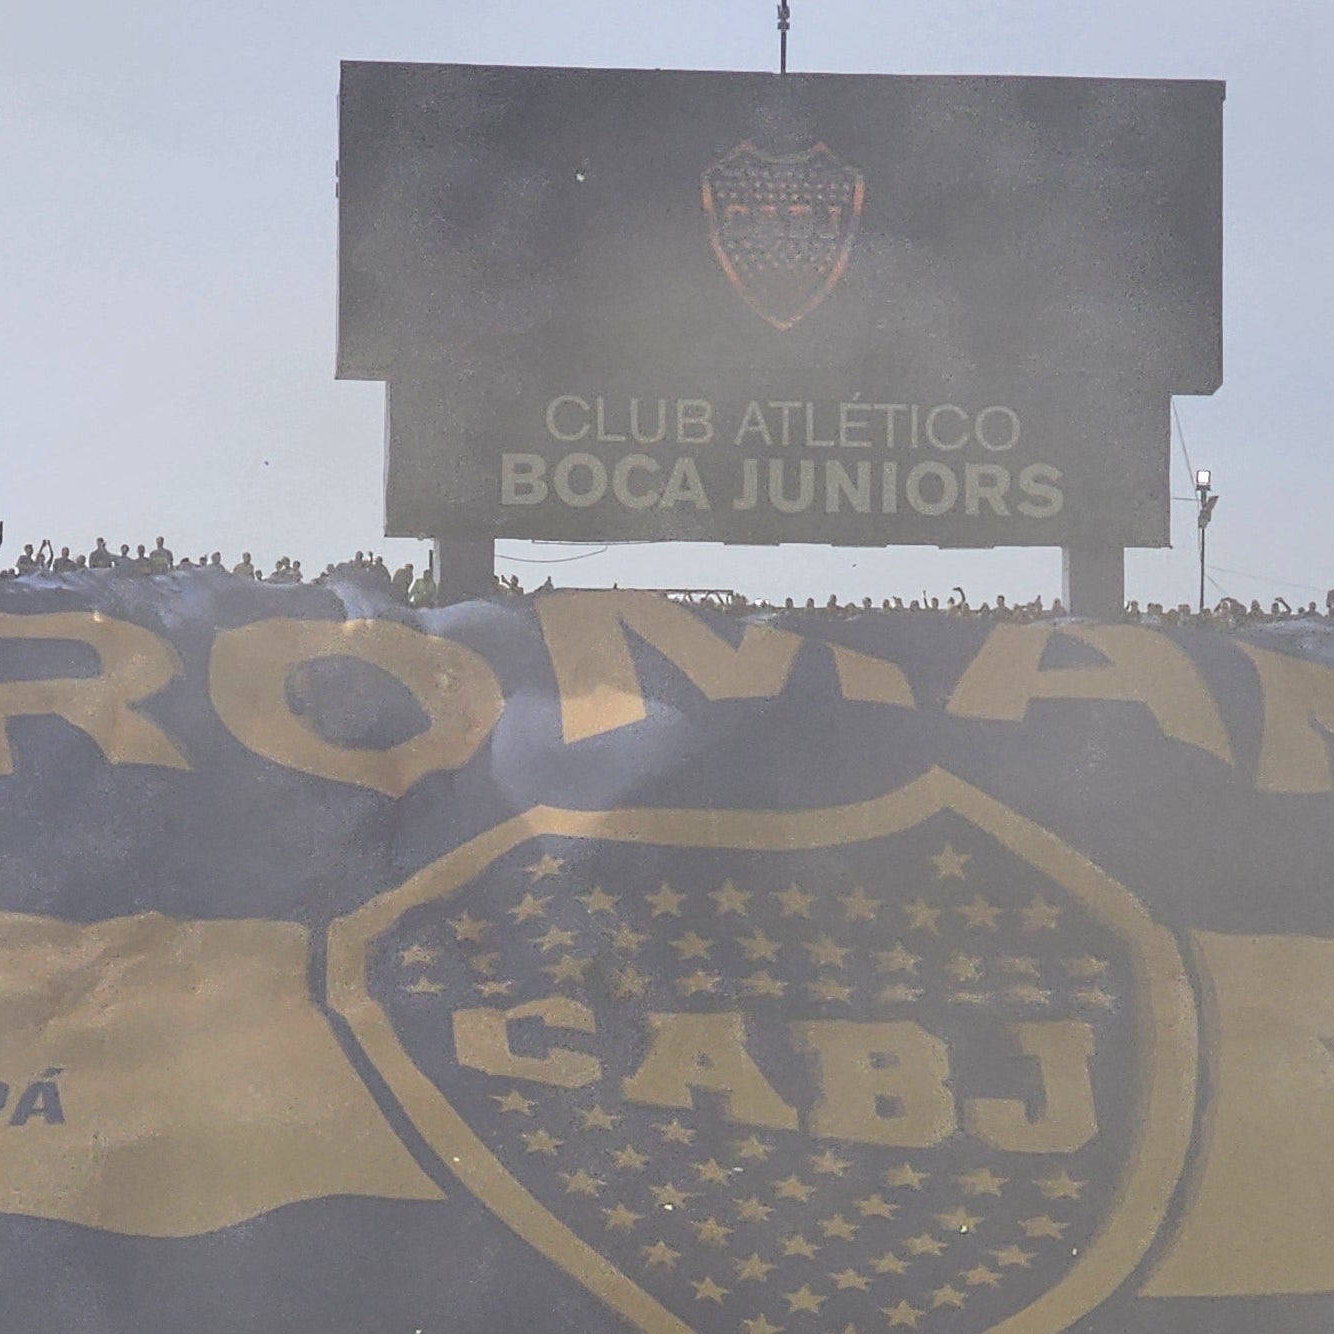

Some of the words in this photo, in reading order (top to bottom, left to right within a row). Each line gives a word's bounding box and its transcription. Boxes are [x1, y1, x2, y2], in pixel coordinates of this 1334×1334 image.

[544, 395, 715, 445] CLUB
[732, 391, 1022, 452] ATLÉTICO
[500, 452, 711, 510] BOCA
[731, 457, 1066, 518] JUNIORS
[452, 997, 1100, 1154] CABJ
